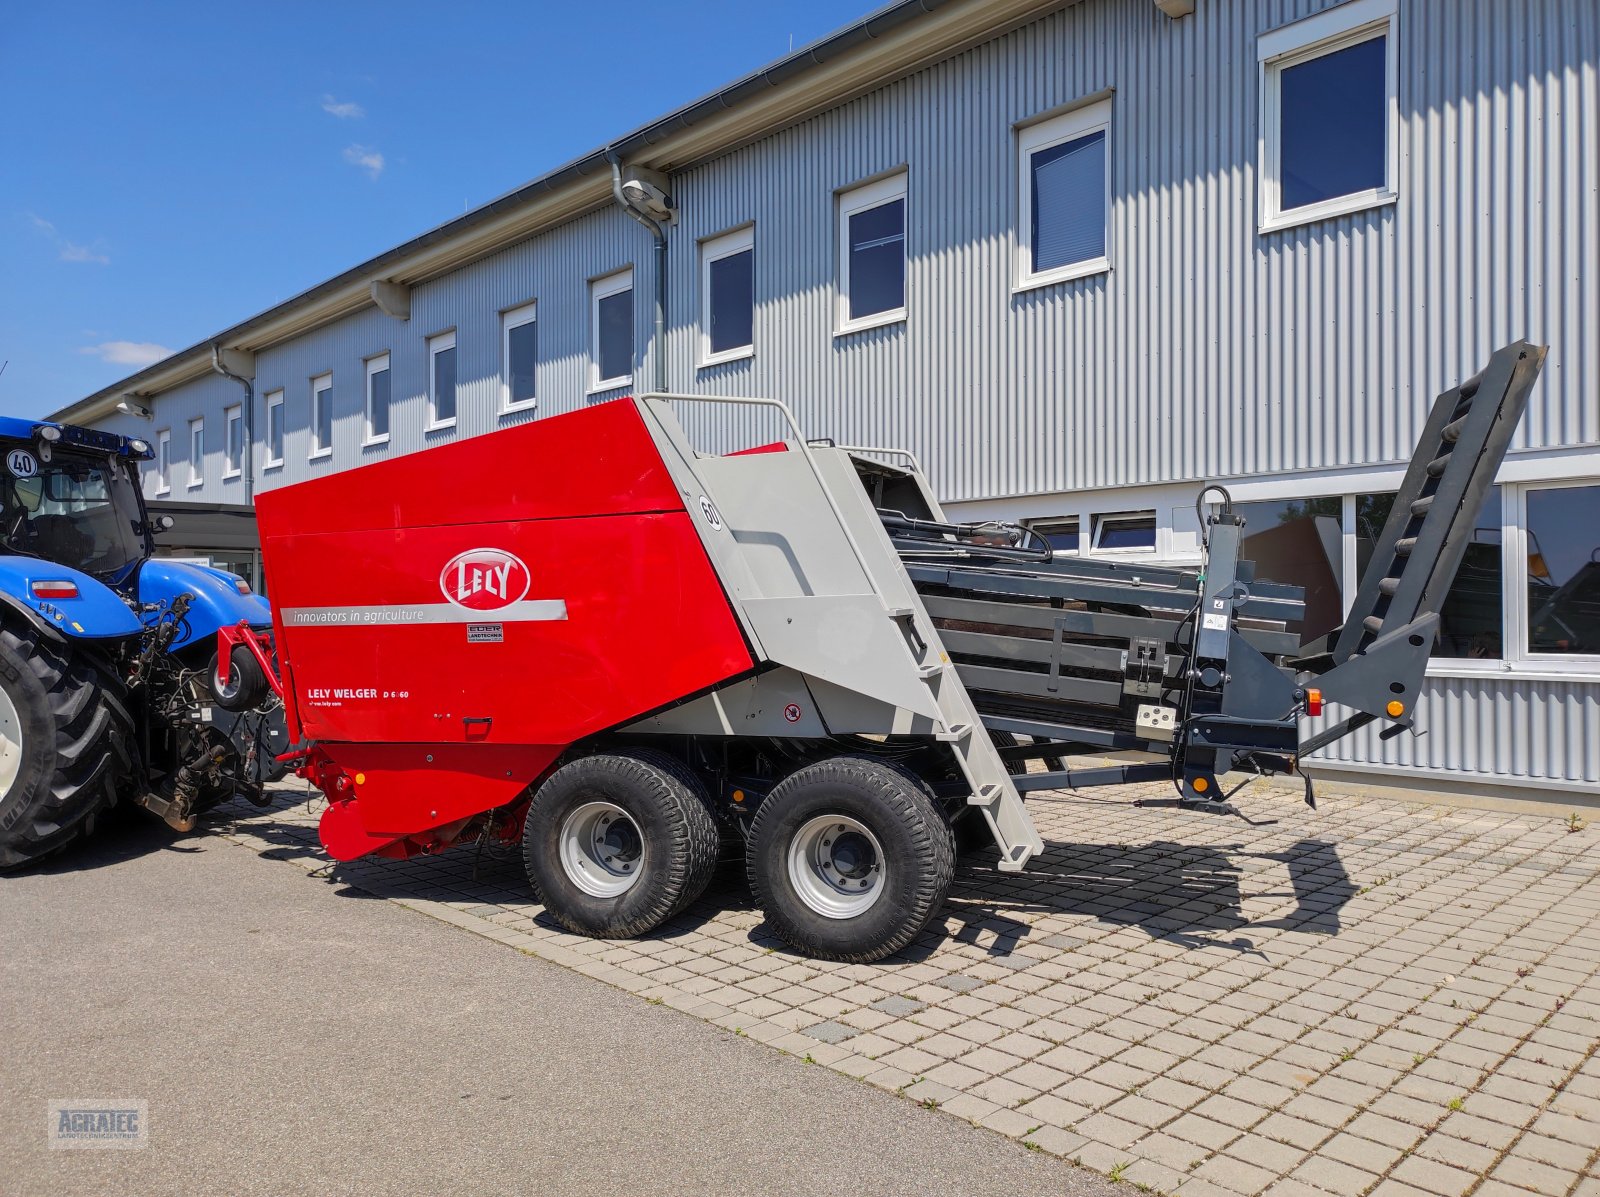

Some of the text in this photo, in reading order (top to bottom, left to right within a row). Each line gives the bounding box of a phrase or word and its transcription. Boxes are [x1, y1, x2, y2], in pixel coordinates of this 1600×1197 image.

[14, 454, 32, 473] 40
[701, 501, 719, 525] 60
[458, 560, 511, 601] LELY
[294, 608, 424, 624] innovators in agriculture
[308, 688, 331, 699] LELY
[333, 688, 378, 699] WELGER
